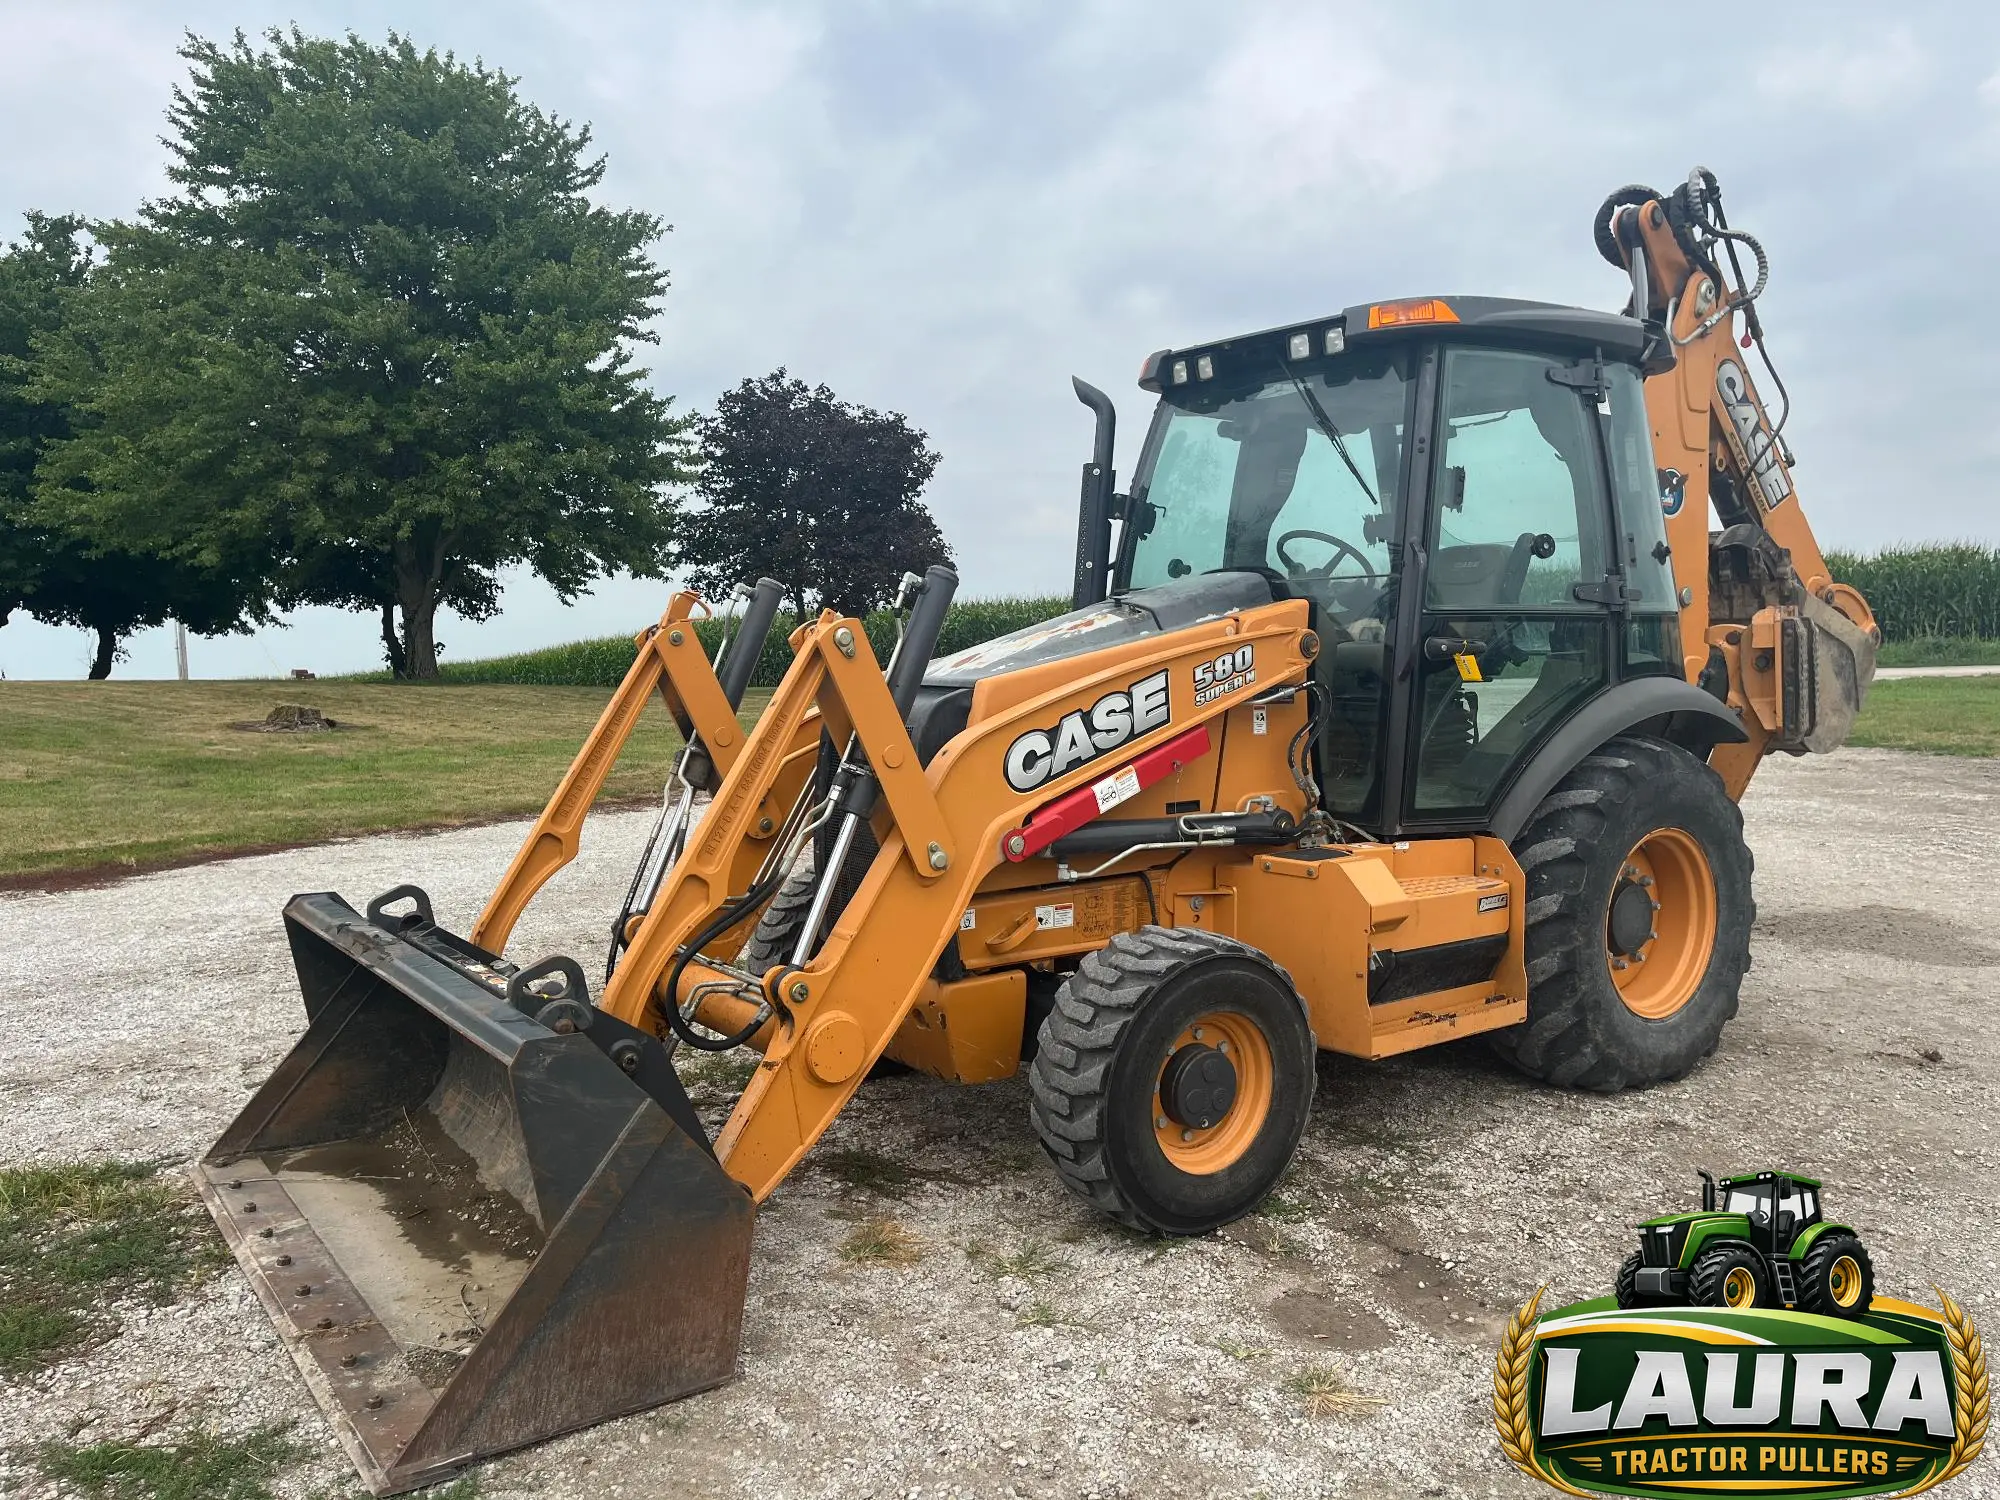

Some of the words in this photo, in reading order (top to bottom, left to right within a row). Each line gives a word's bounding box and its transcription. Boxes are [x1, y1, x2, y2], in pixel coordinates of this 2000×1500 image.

[1717, 360, 1791, 510] CASE
[1193, 644, 1254, 692] 580
[1195, 677, 1244, 707] SUPER
[1245, 669, 1256, 686] N
[1004, 669, 1170, 792] CASE
